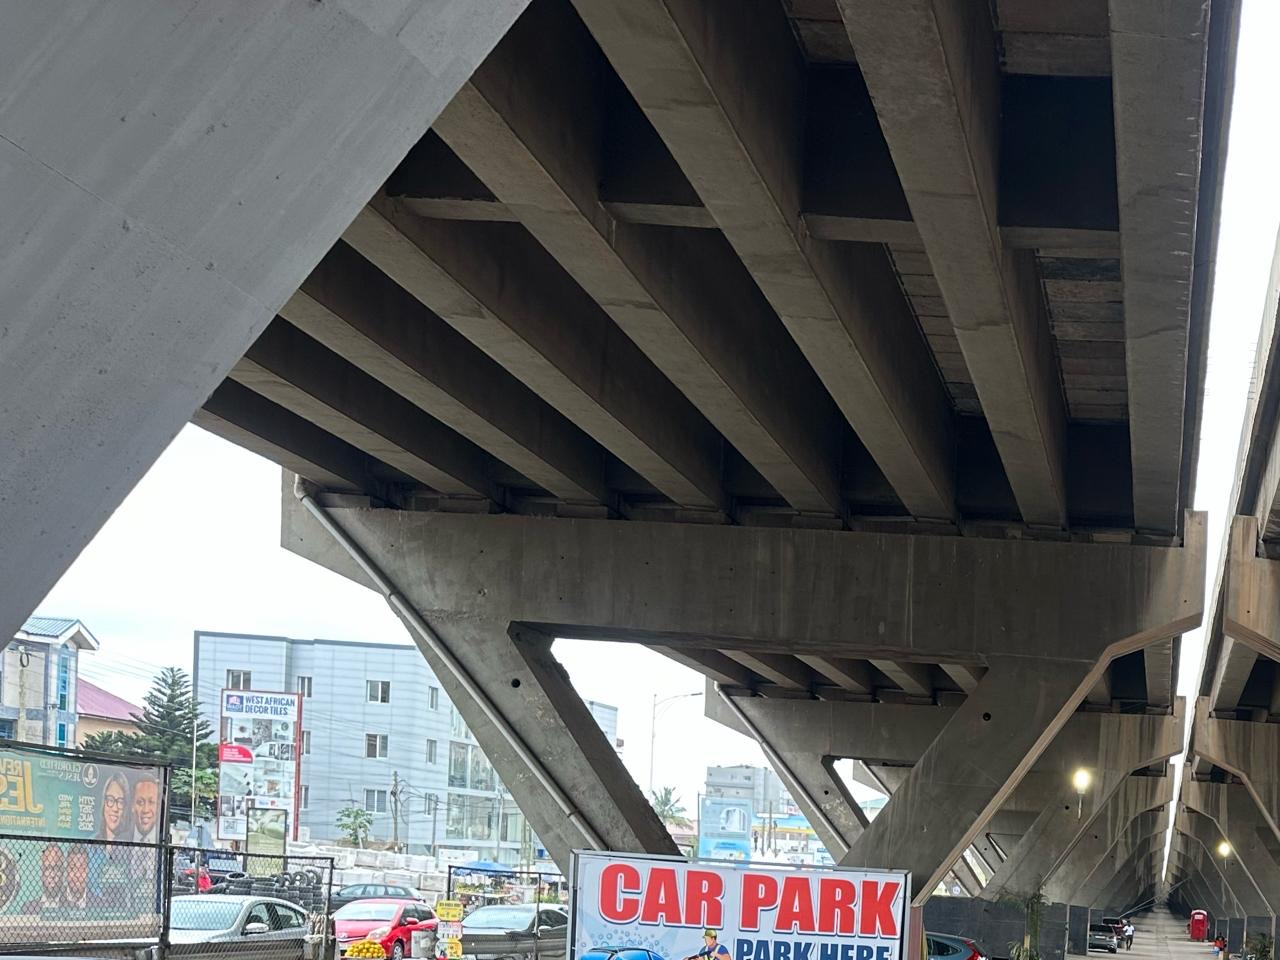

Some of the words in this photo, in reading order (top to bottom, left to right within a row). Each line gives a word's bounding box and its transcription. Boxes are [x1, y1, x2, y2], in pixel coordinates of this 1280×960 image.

[245, 696, 264, 705] WEST
[265, 697, 295, 706] AFRICAN
[245, 705, 269, 714] DECOR
[270, 707, 288, 715] TILES
[599, 863, 724, 927] CAR
[739, 873, 901, 937] PARK
